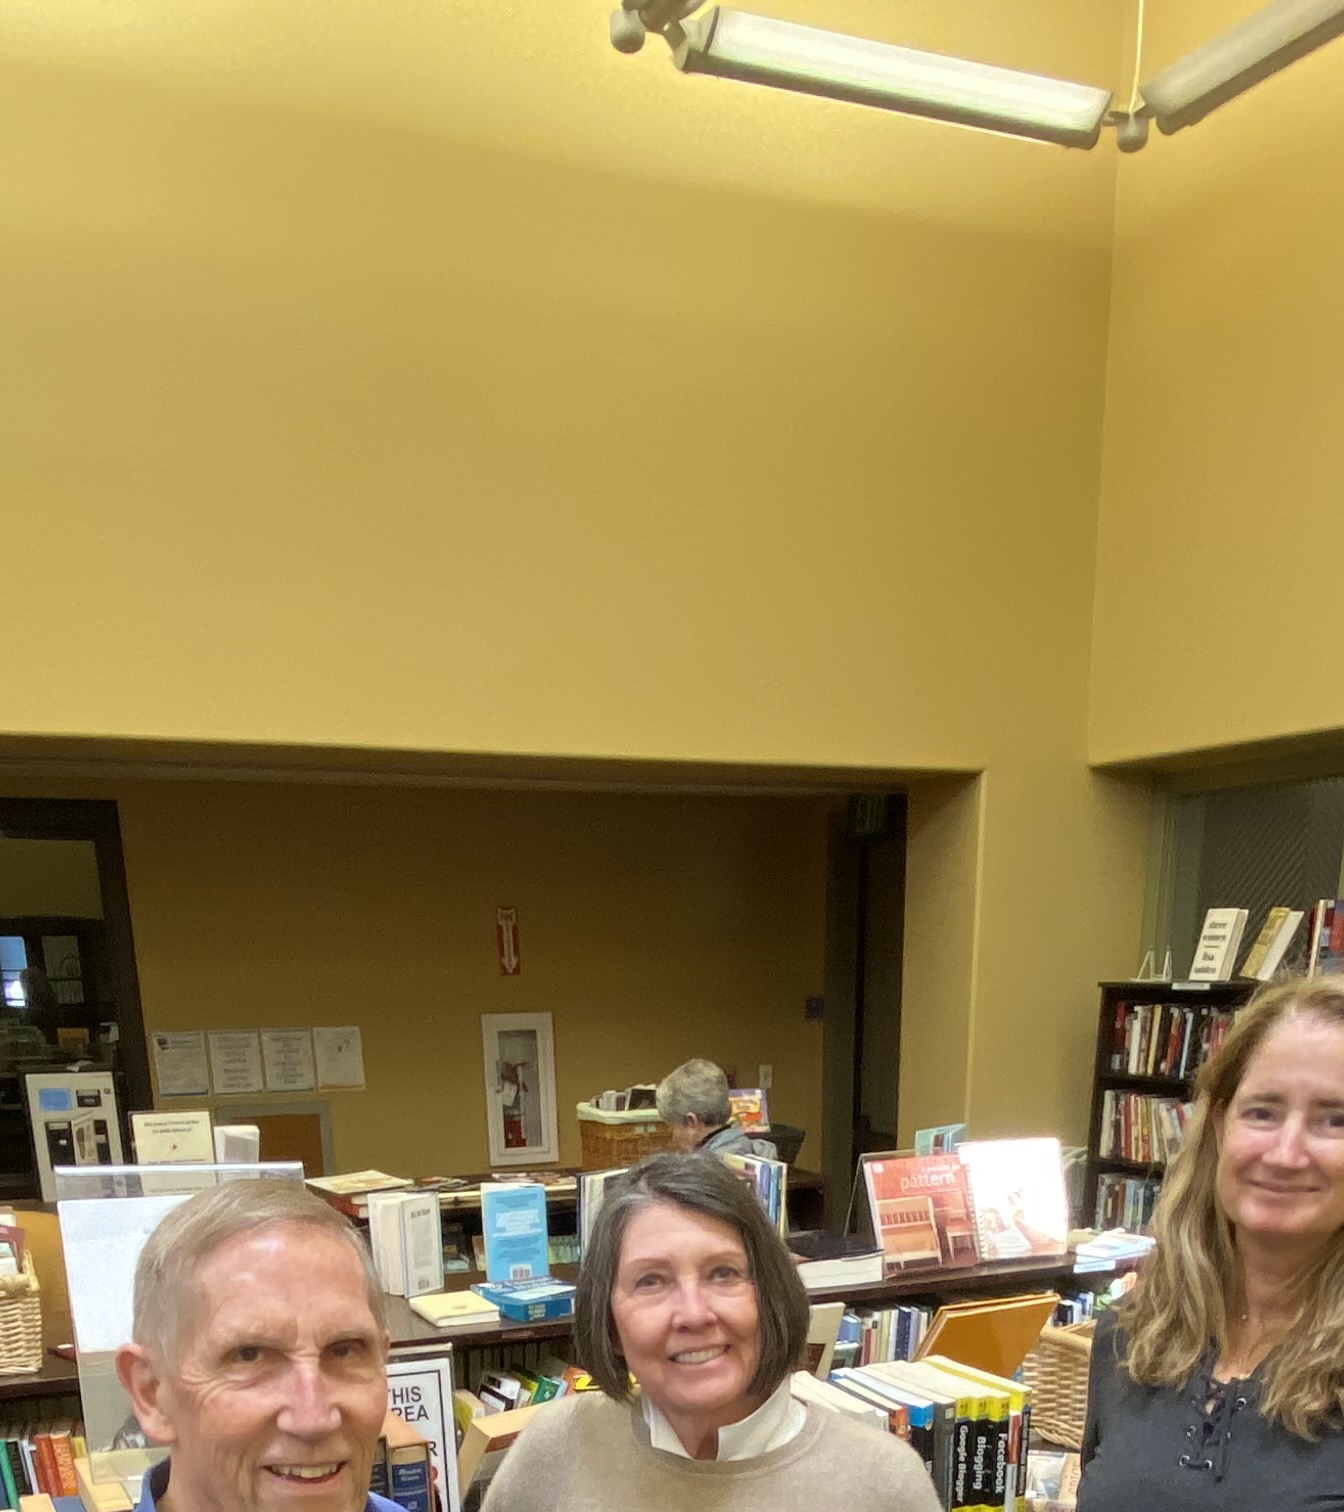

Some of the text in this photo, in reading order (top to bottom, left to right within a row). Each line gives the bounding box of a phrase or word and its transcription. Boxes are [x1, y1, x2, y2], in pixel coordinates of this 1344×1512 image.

[900, 1172, 956, 1192] pattern
[389, 1386, 422, 1405] HIS
[390, 1405, 430, 1423] REA
[957, 1425, 969, 1462] Google
[972, 1436, 987, 1490] Blogging
[995, 1433, 1008, 1494] Facebook
[955, 1463, 967, 1504] Blogger
